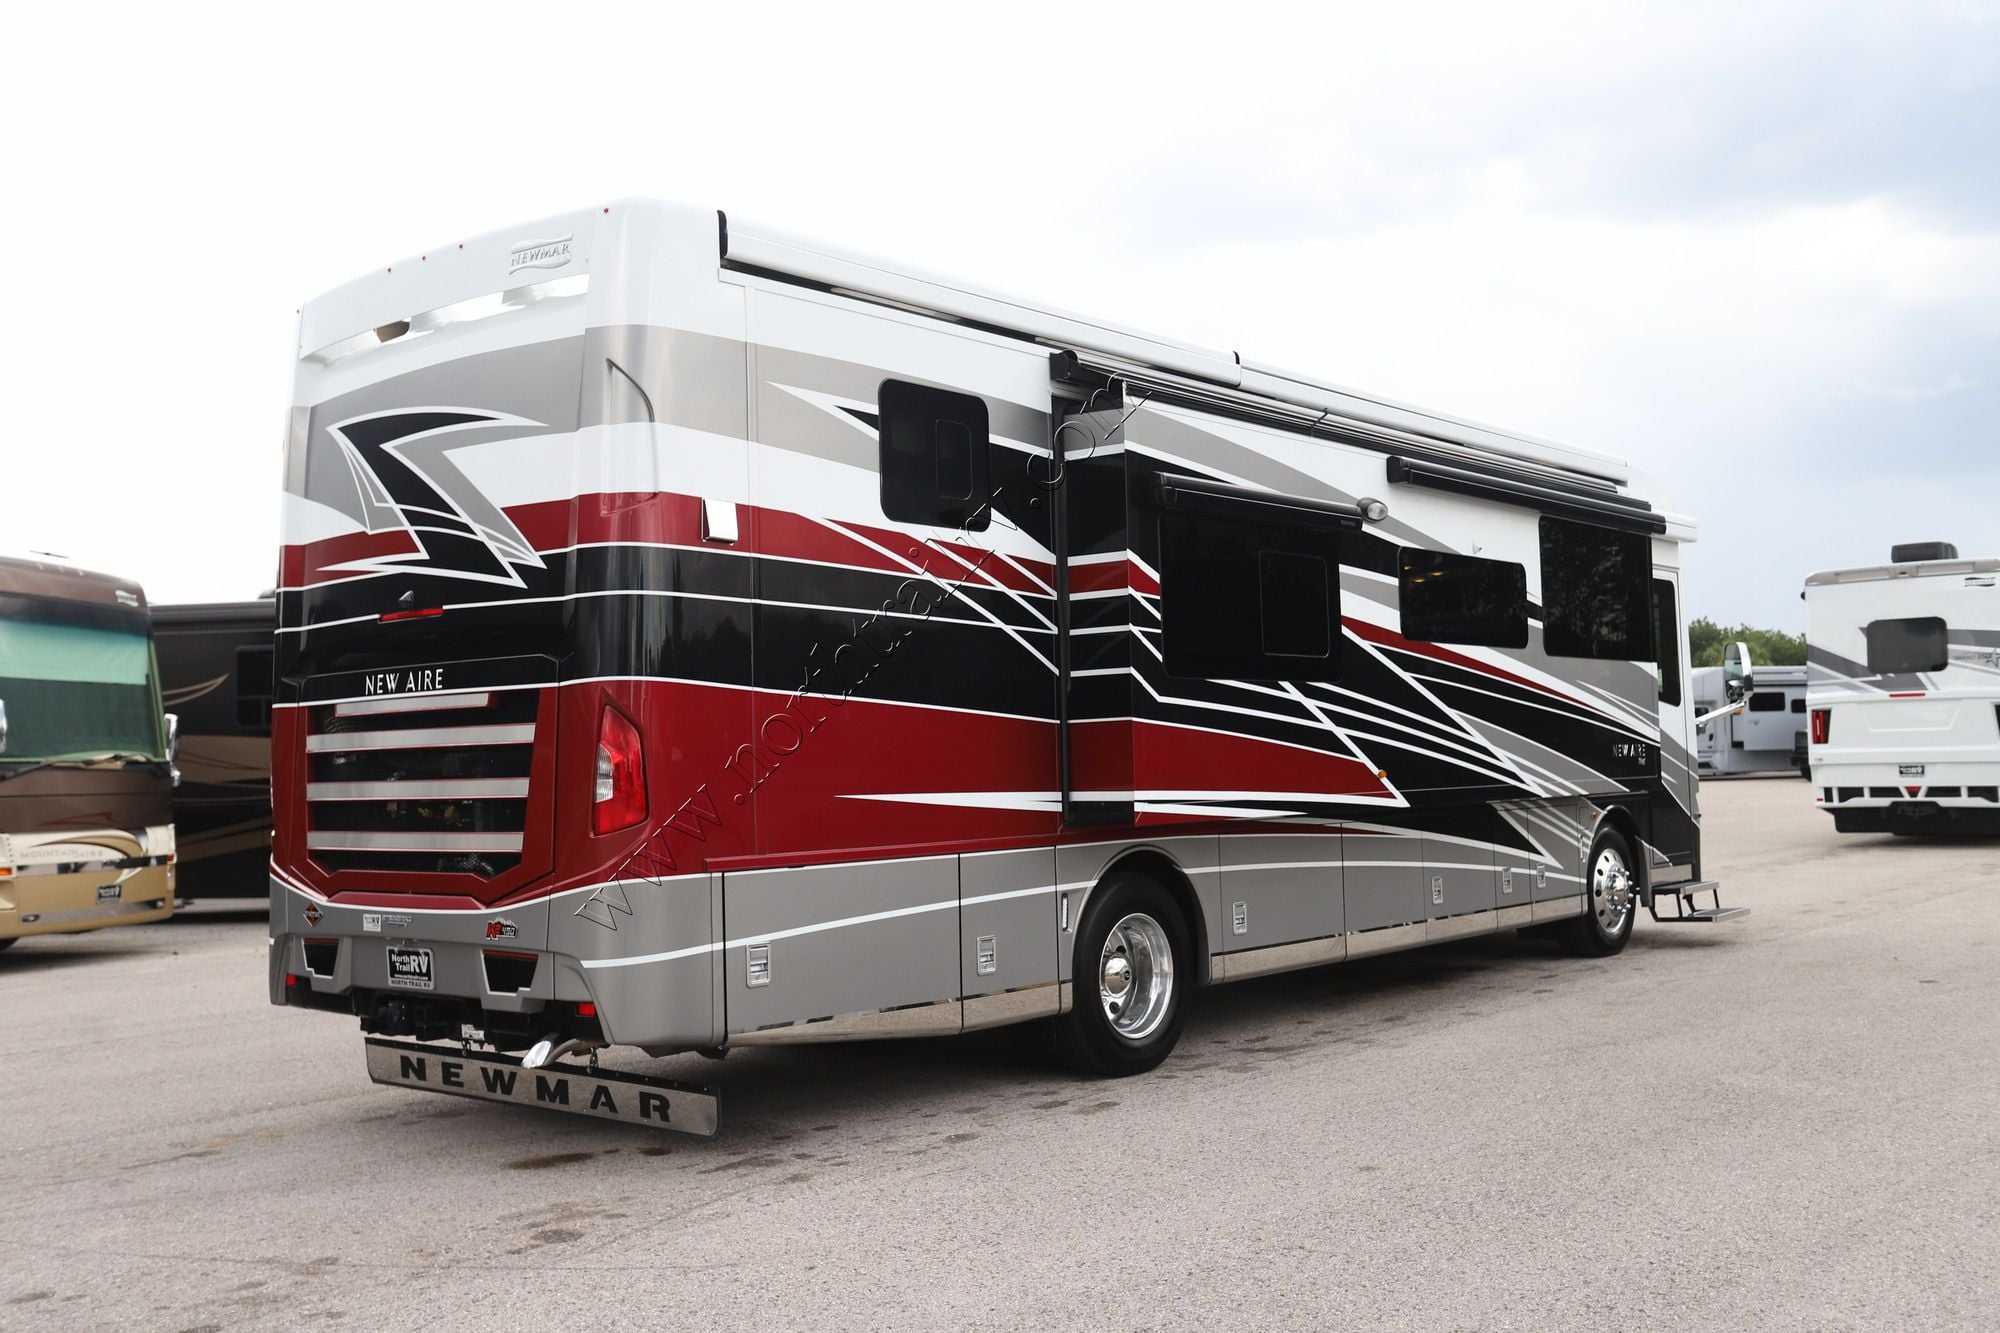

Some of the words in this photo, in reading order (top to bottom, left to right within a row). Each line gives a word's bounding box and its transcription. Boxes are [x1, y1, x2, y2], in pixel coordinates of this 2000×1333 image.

[511, 243, 571, 267] NEWMAR
[365, 672, 400, 696] NEW
[405, 668, 443, 692] AIRE
[1612, 743, 1629, 757] NEW
[1630, 743, 1646, 757] AIRE
[391, 953, 410, 963] North
[395, 962, 411, 972] Trail
[410, 954, 429, 973] RV
[400, 1055, 671, 1123] NEWMAR
